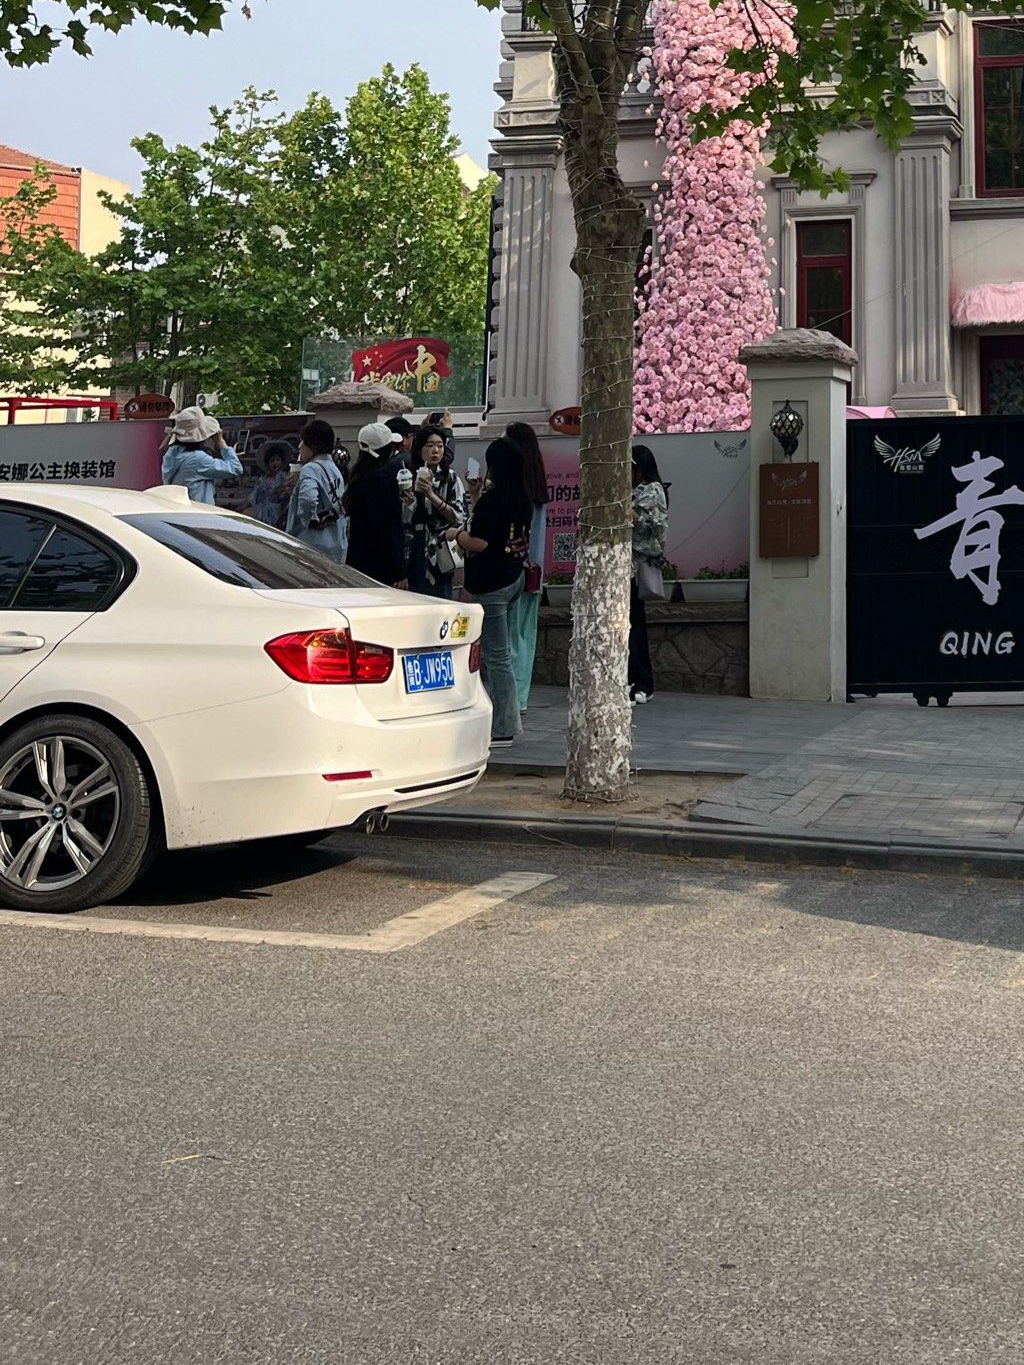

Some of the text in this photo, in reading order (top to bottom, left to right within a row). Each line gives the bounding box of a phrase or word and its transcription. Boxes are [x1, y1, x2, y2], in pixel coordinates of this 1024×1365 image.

[0, 460, 116, 481] 安娜公主换装馆
[939, 631, 1016, 656] QING
